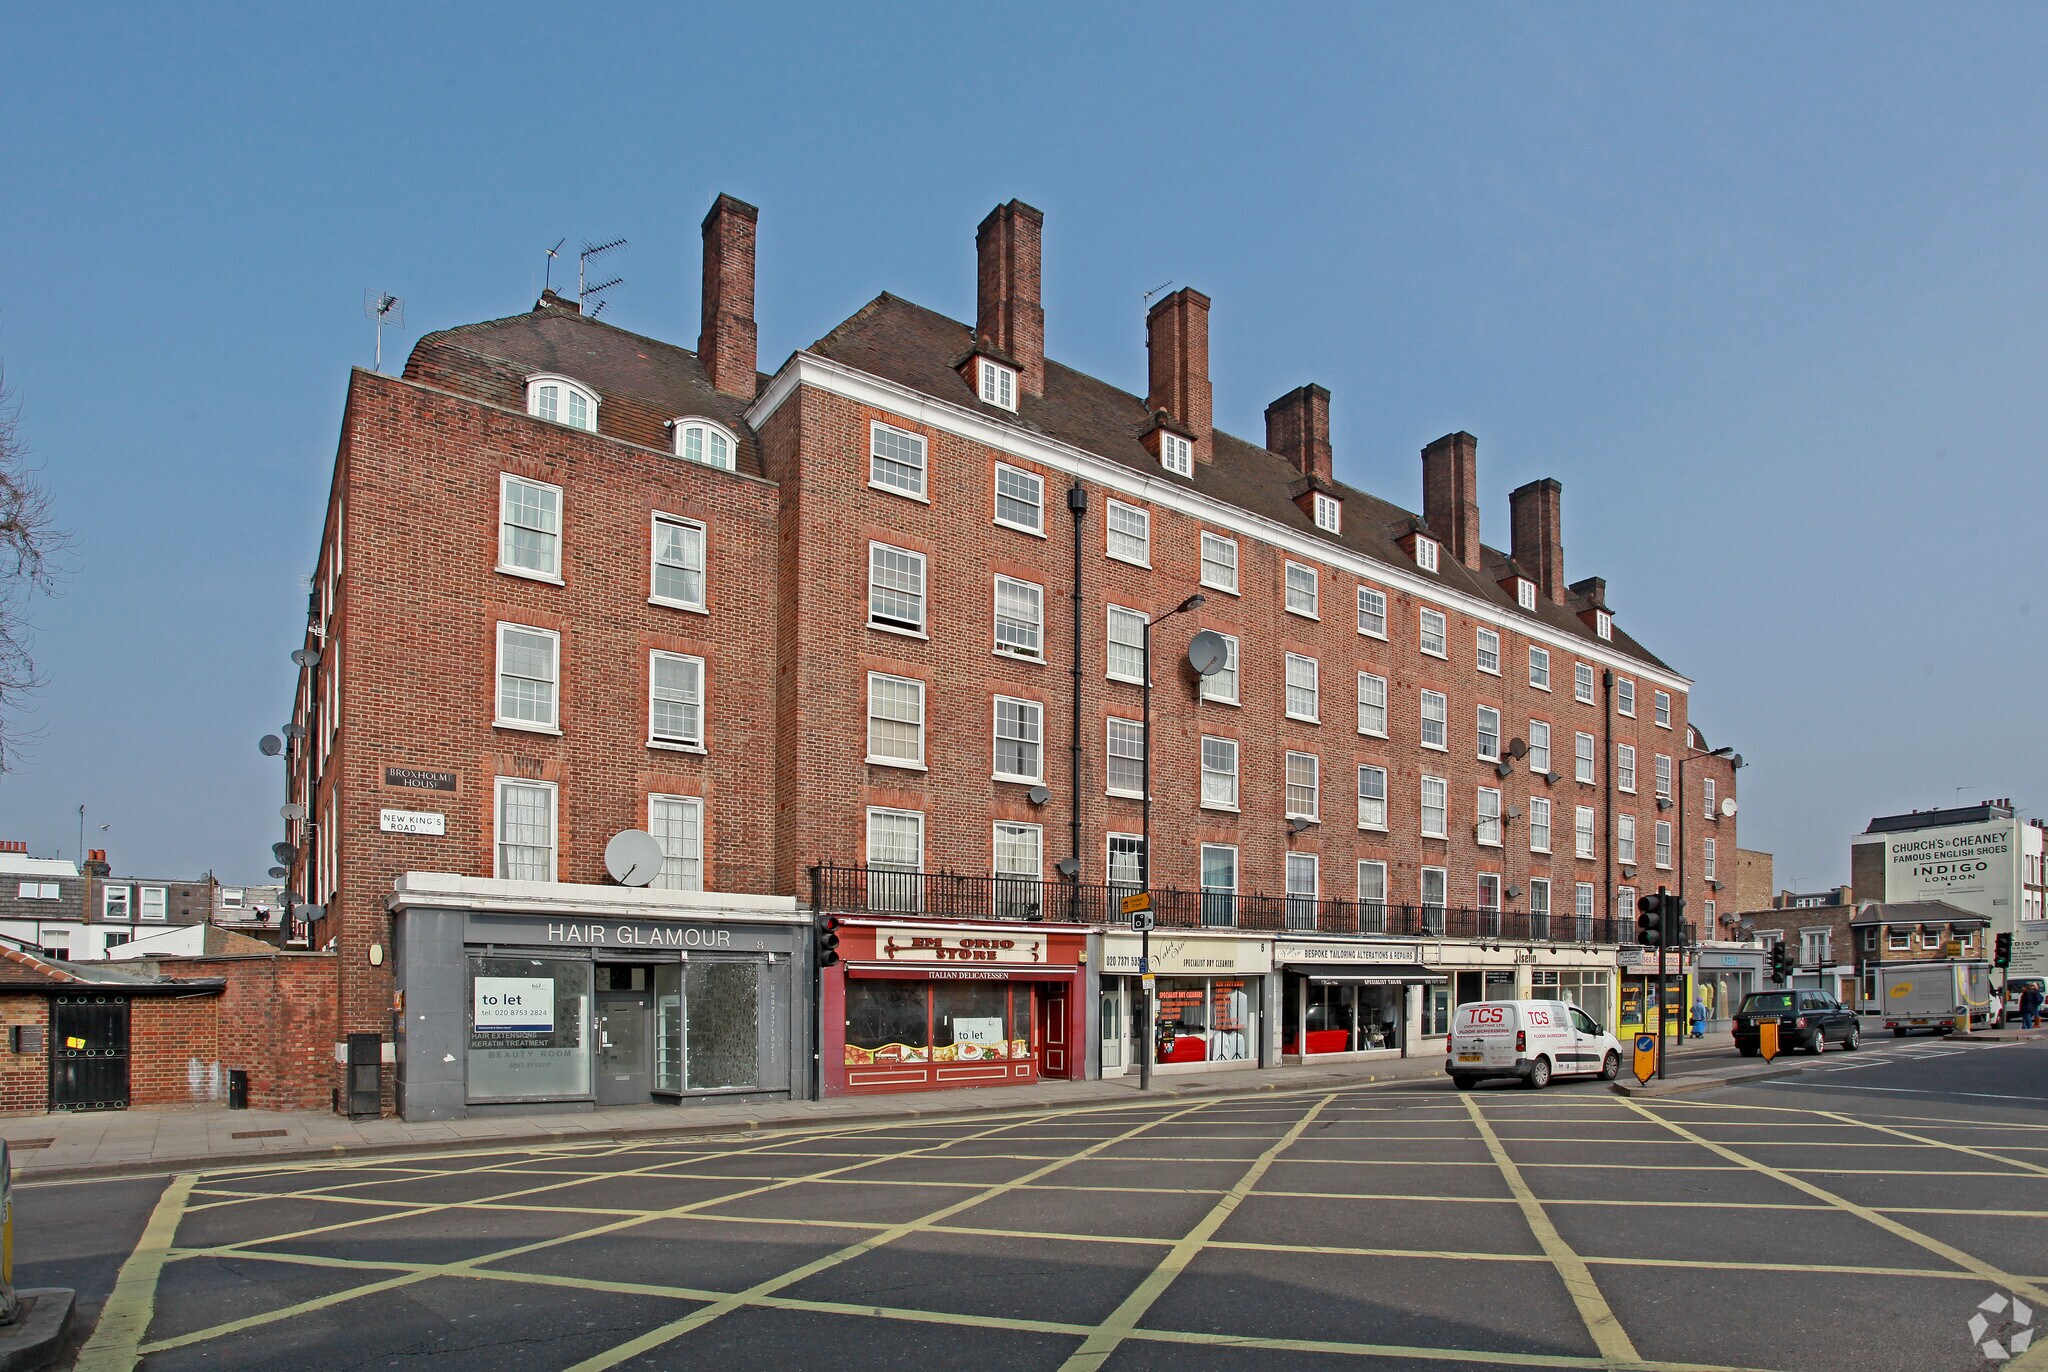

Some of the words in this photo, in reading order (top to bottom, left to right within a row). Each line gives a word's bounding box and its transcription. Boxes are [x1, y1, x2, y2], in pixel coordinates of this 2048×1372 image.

[383, 814, 405, 823] NEW
[409, 816, 442, 826] KING'S
[390, 823, 417, 832] ROAD
[1892, 838, 1944, 854] CHURCH'S
[1952, 832, 2007, 847] CHEANEY
[1893, 852, 1932, 863] FAMOUS
[1933, 849, 1974, 860] ENGLISH
[1976, 845, 2007, 855] SHOES
[1913, 862, 1988, 876] INDIGO
[1924, 874, 1976, 882] LONDON
[548, 923, 606, 943] HAIR
[616, 925, 731, 947] GLAMOUR
[756, 940, 764, 950] 8
[1260, 943, 1265, 952] 6
[936, 950, 998, 961] STORE
[1304, 949, 1328, 959] BESPOKE
[1329, 949, 1353, 960] TAILORING
[1356, 950, 1389, 960] ALTERATIONS
[1389, 951, 1394, 960] &
[1394, 951, 1413, 960] REPAIRS
[1106, 955, 1117, 966] 020
[1117, 956, 1130, 967] 7371
[1183, 959, 1206, 968] SPECIALIST
[1206, 959, 1215, 967] DRY
[1215, 959, 1235, 968] CLEANERS
[929, 971, 957, 979] ITALIAN
[482, 995, 498, 1005] to
[503, 993, 522, 1005] let
[1158, 991, 1178, 999] SPECIALIST
[1469, 1008, 1503, 1023] TCS
[1527, 1011, 1550, 1025] TCS
[958, 1031, 969, 1039] to
[971, 1029, 983, 1039] let
[506, 1039, 549, 1047] TREATMENT
[488, 1051, 534, 1059] BEAUTY
